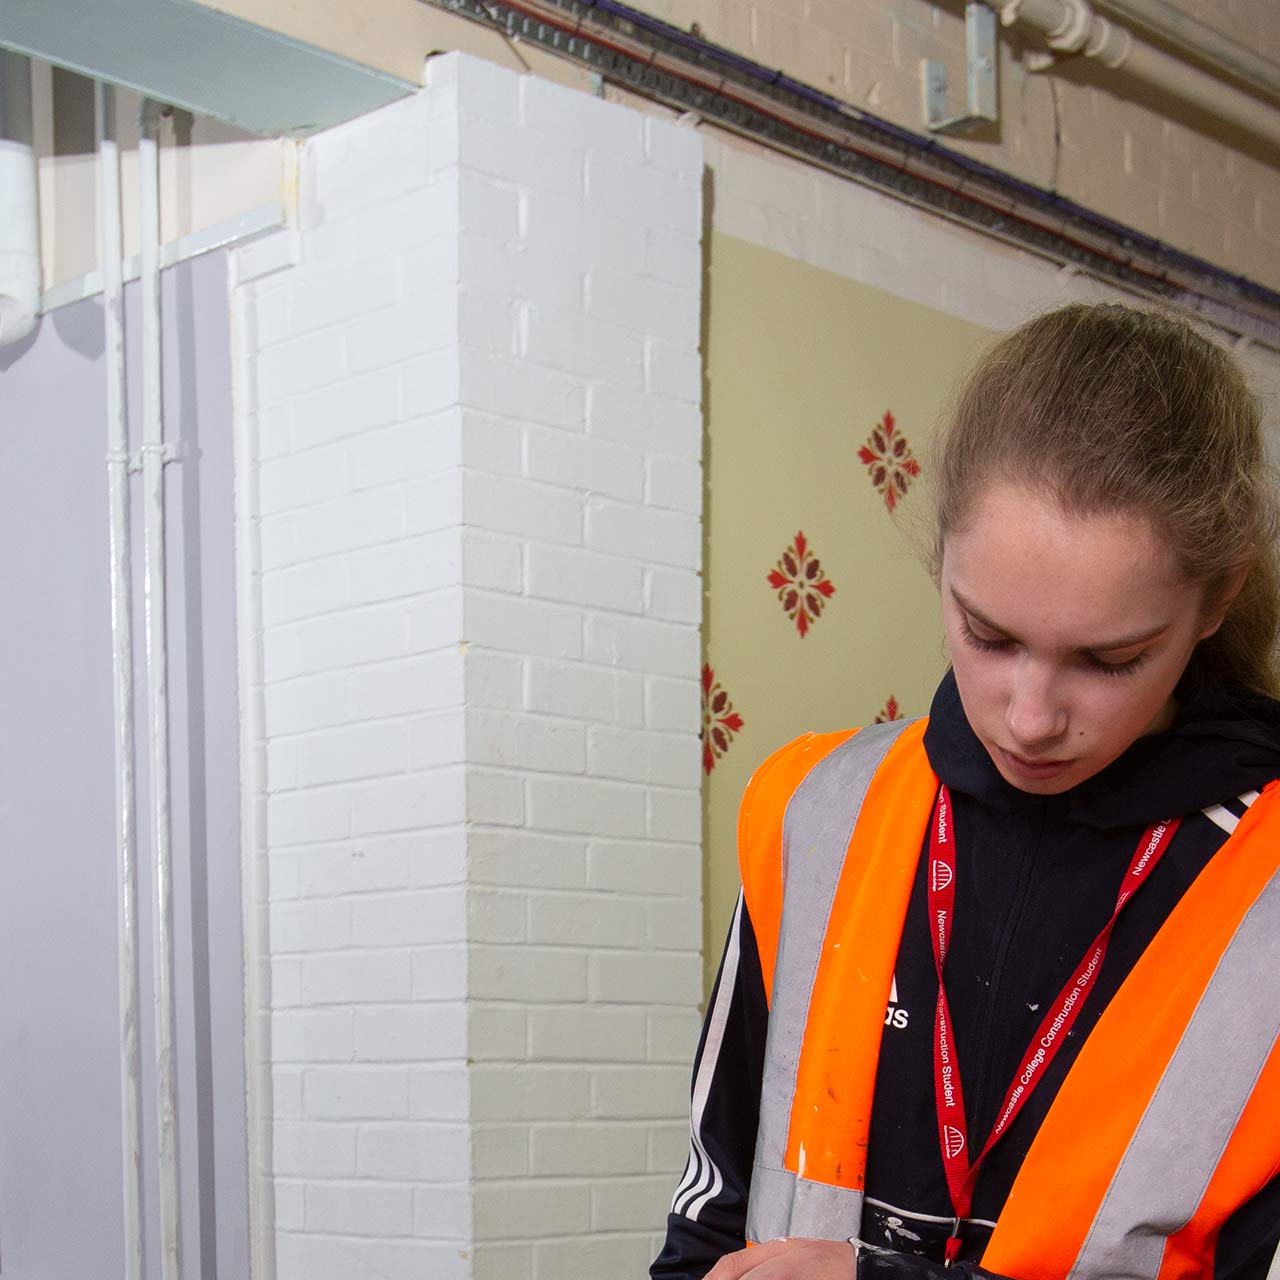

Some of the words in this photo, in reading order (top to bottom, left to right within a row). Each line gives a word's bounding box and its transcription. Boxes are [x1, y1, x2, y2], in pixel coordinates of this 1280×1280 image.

[1132, 825, 1167, 876] Newcastle
[995, 1085, 1024, 1134] Newcastle
[1020, 1048, 1046, 1085] College
[1041, 987, 1082, 1047] Construction
[1077, 948, 1103, 987] Student
[942, 1066, 956, 1108] Student
